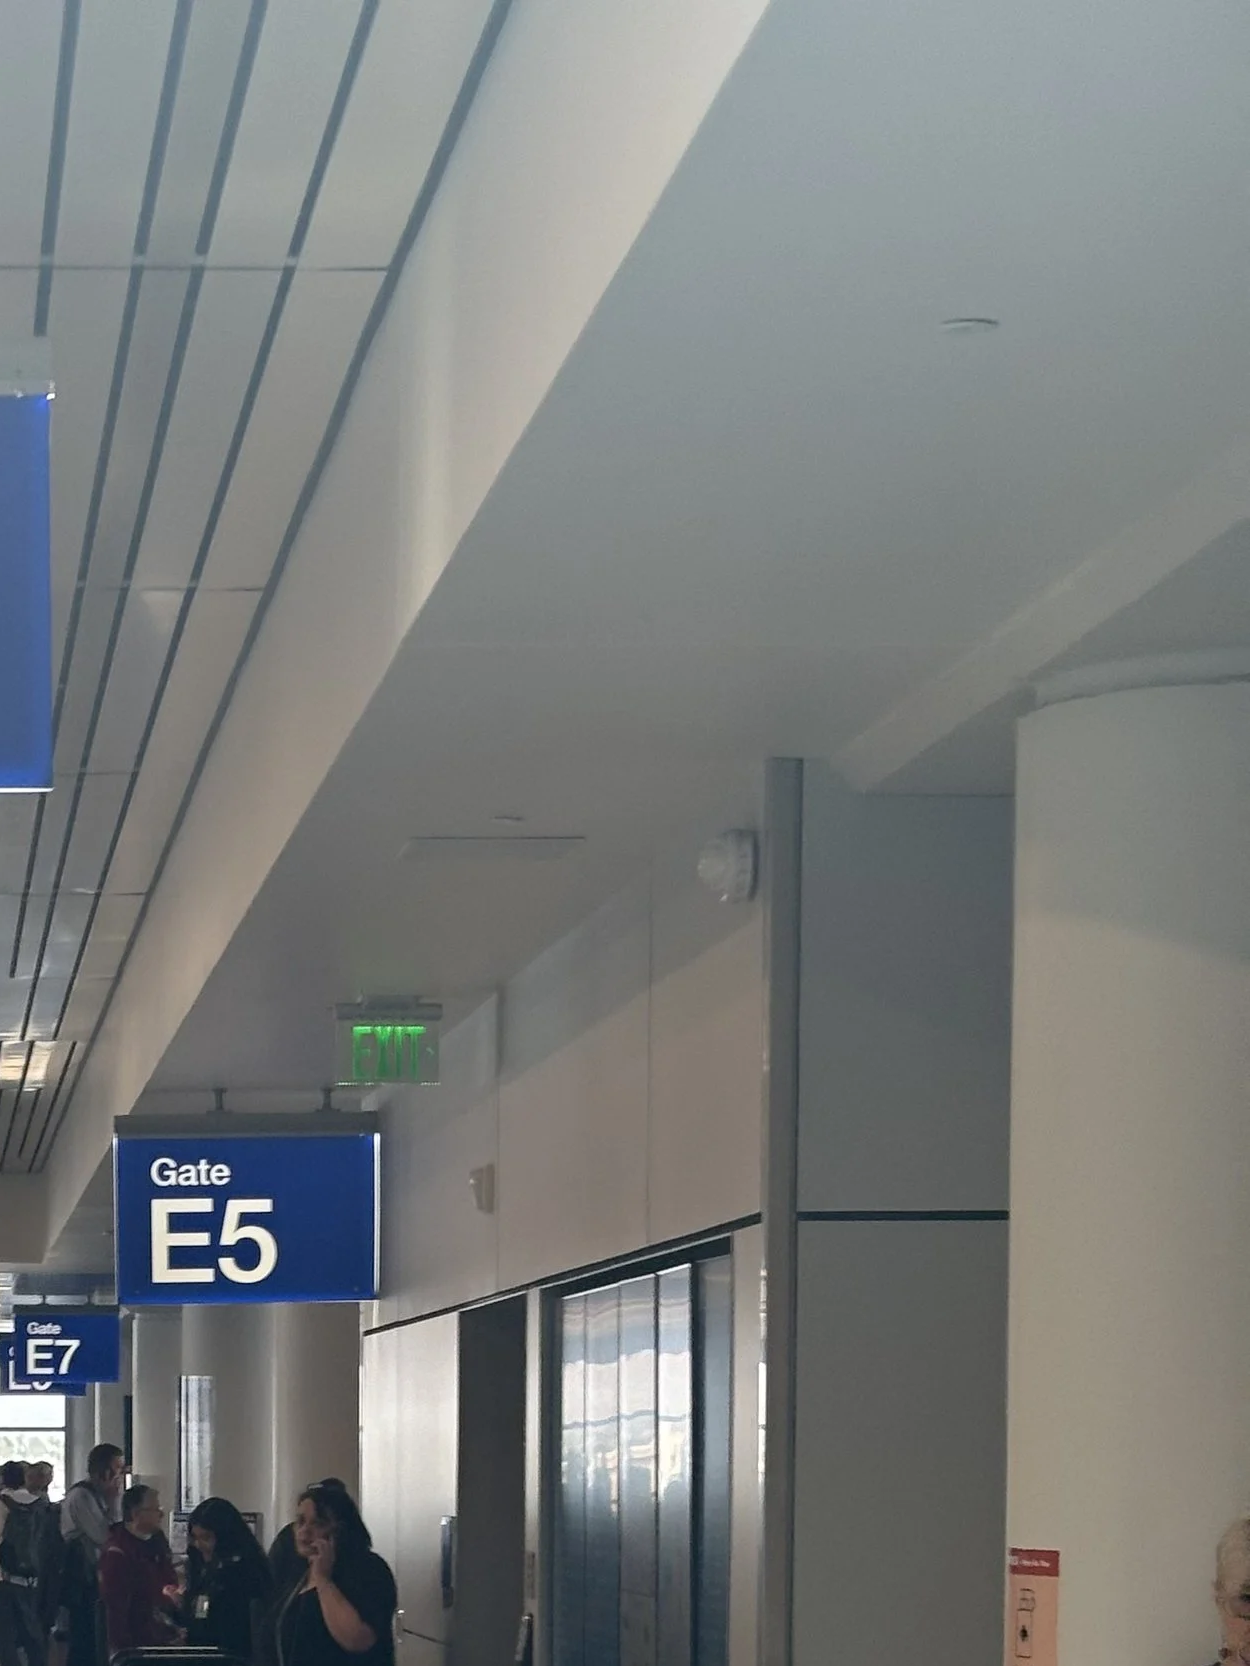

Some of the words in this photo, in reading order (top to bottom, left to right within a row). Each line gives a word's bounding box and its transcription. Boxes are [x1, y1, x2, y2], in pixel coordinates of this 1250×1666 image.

[352, 1025, 427, 1080] EXIT
[150, 1157, 232, 1187] Gate
[150, 1198, 279, 1285] E5
[26, 1321, 63, 1335] Gate
[26, 1338, 81, 1375] E7
